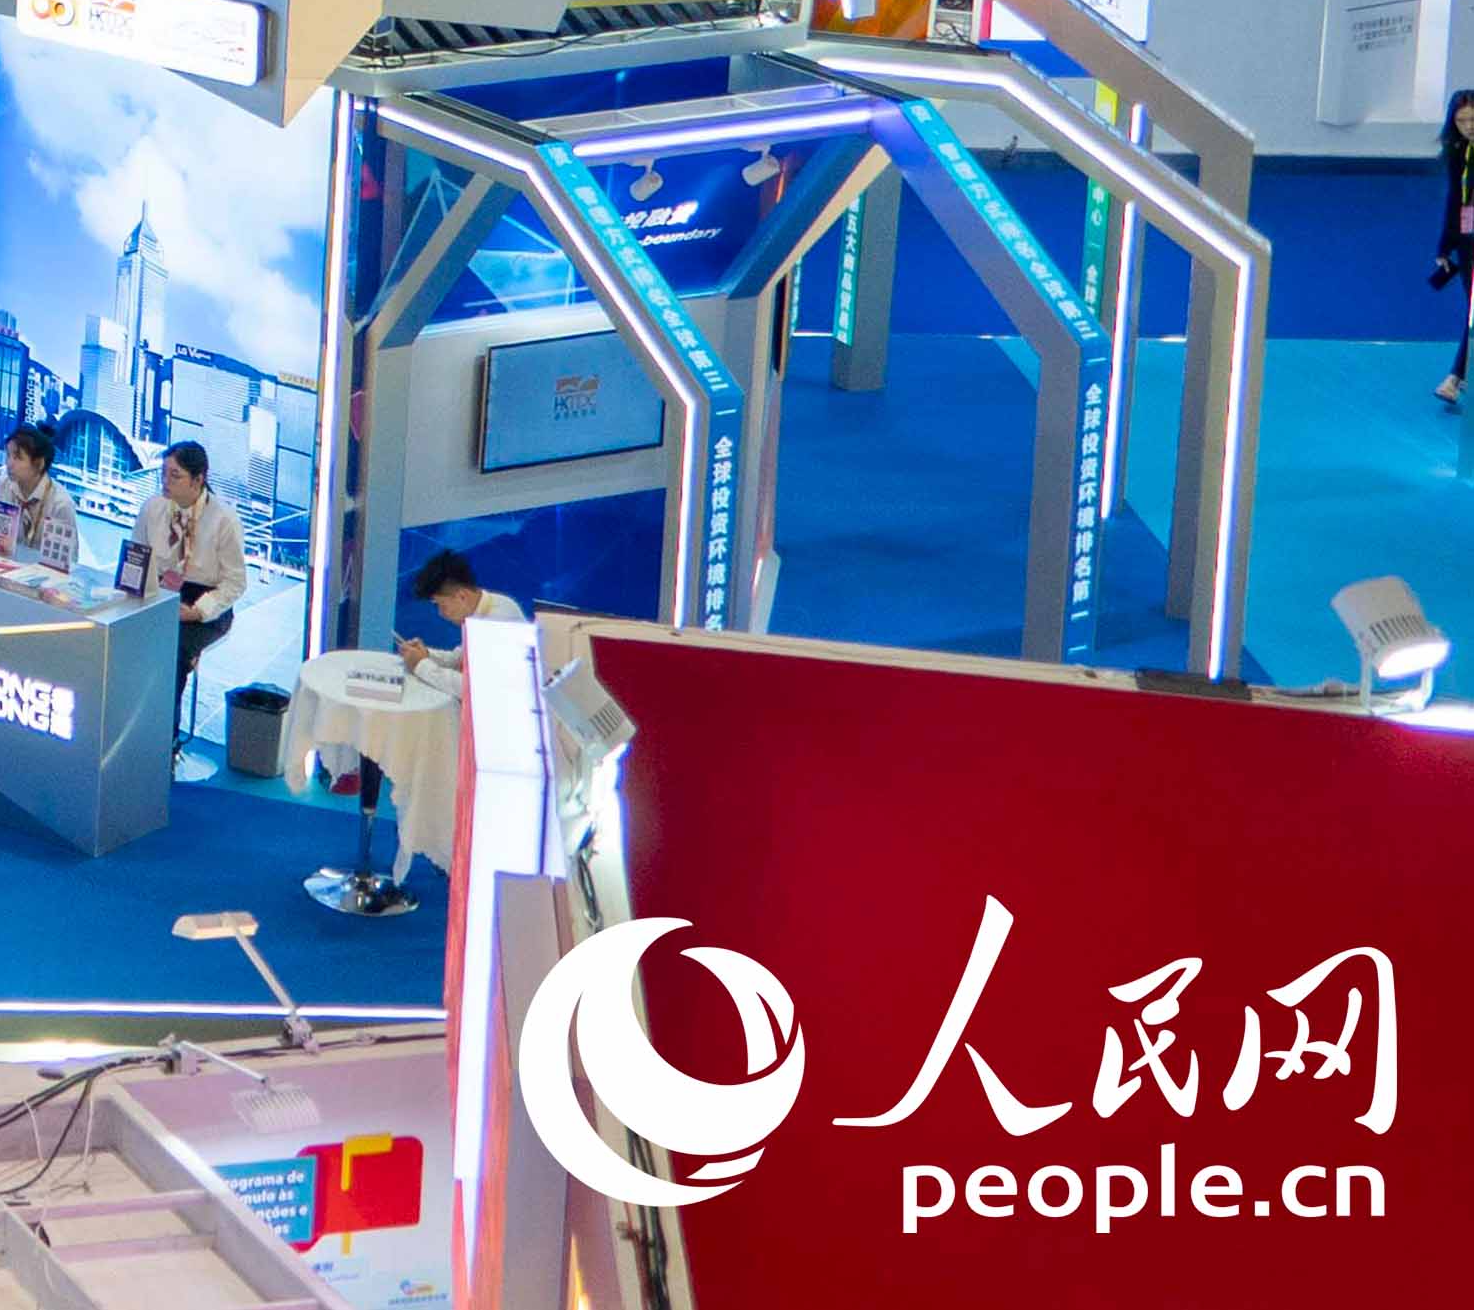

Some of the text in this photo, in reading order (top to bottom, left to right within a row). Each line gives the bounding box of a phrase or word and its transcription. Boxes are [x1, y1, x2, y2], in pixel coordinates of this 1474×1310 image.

[1069, 382, 1103, 623] 全球投资环境排名第一
[286, 1170, 304, 1185] de
